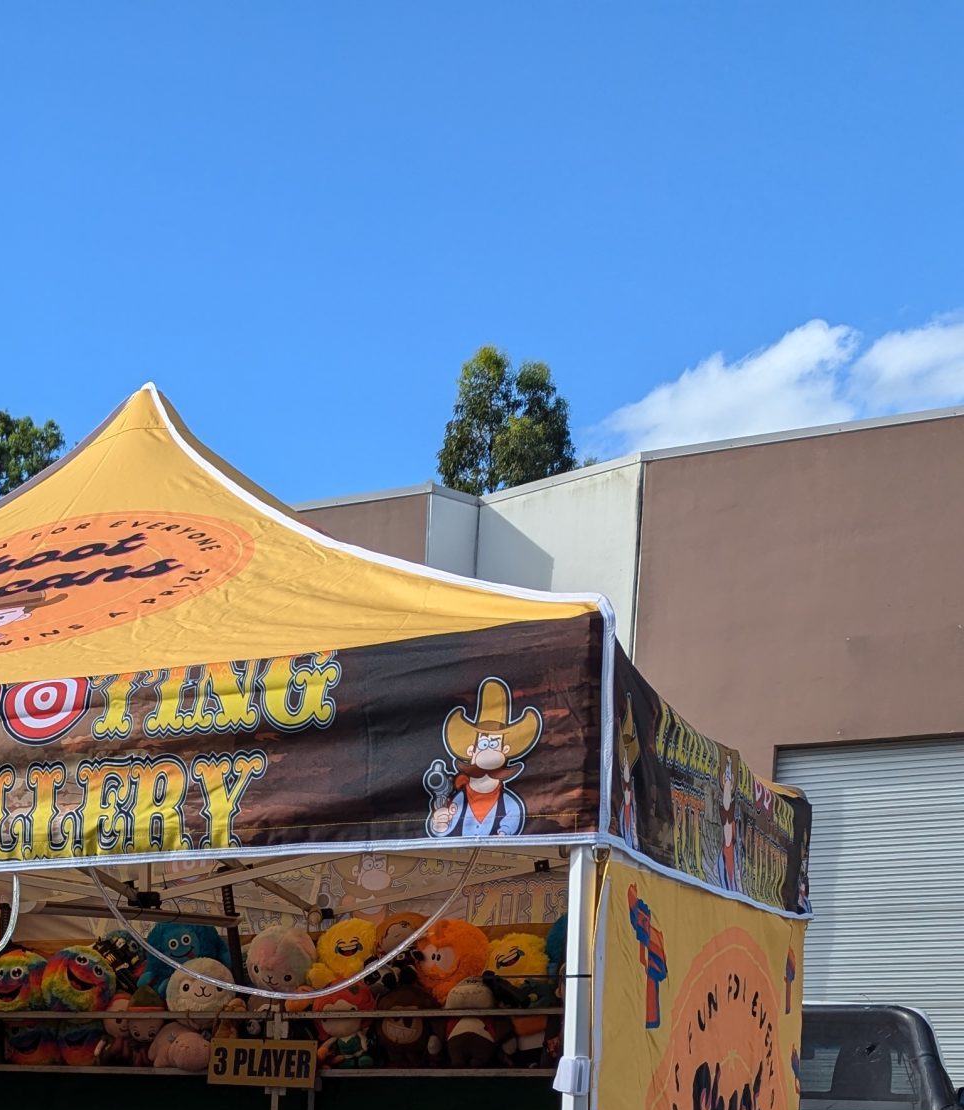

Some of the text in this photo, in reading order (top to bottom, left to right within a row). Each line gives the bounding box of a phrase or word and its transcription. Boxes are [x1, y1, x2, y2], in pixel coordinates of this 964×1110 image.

[31, 522, 91, 541] FOR
[109, 520, 222, 552] EVERYONE
[214, 1047, 311, 1078] 3 PLAYER
